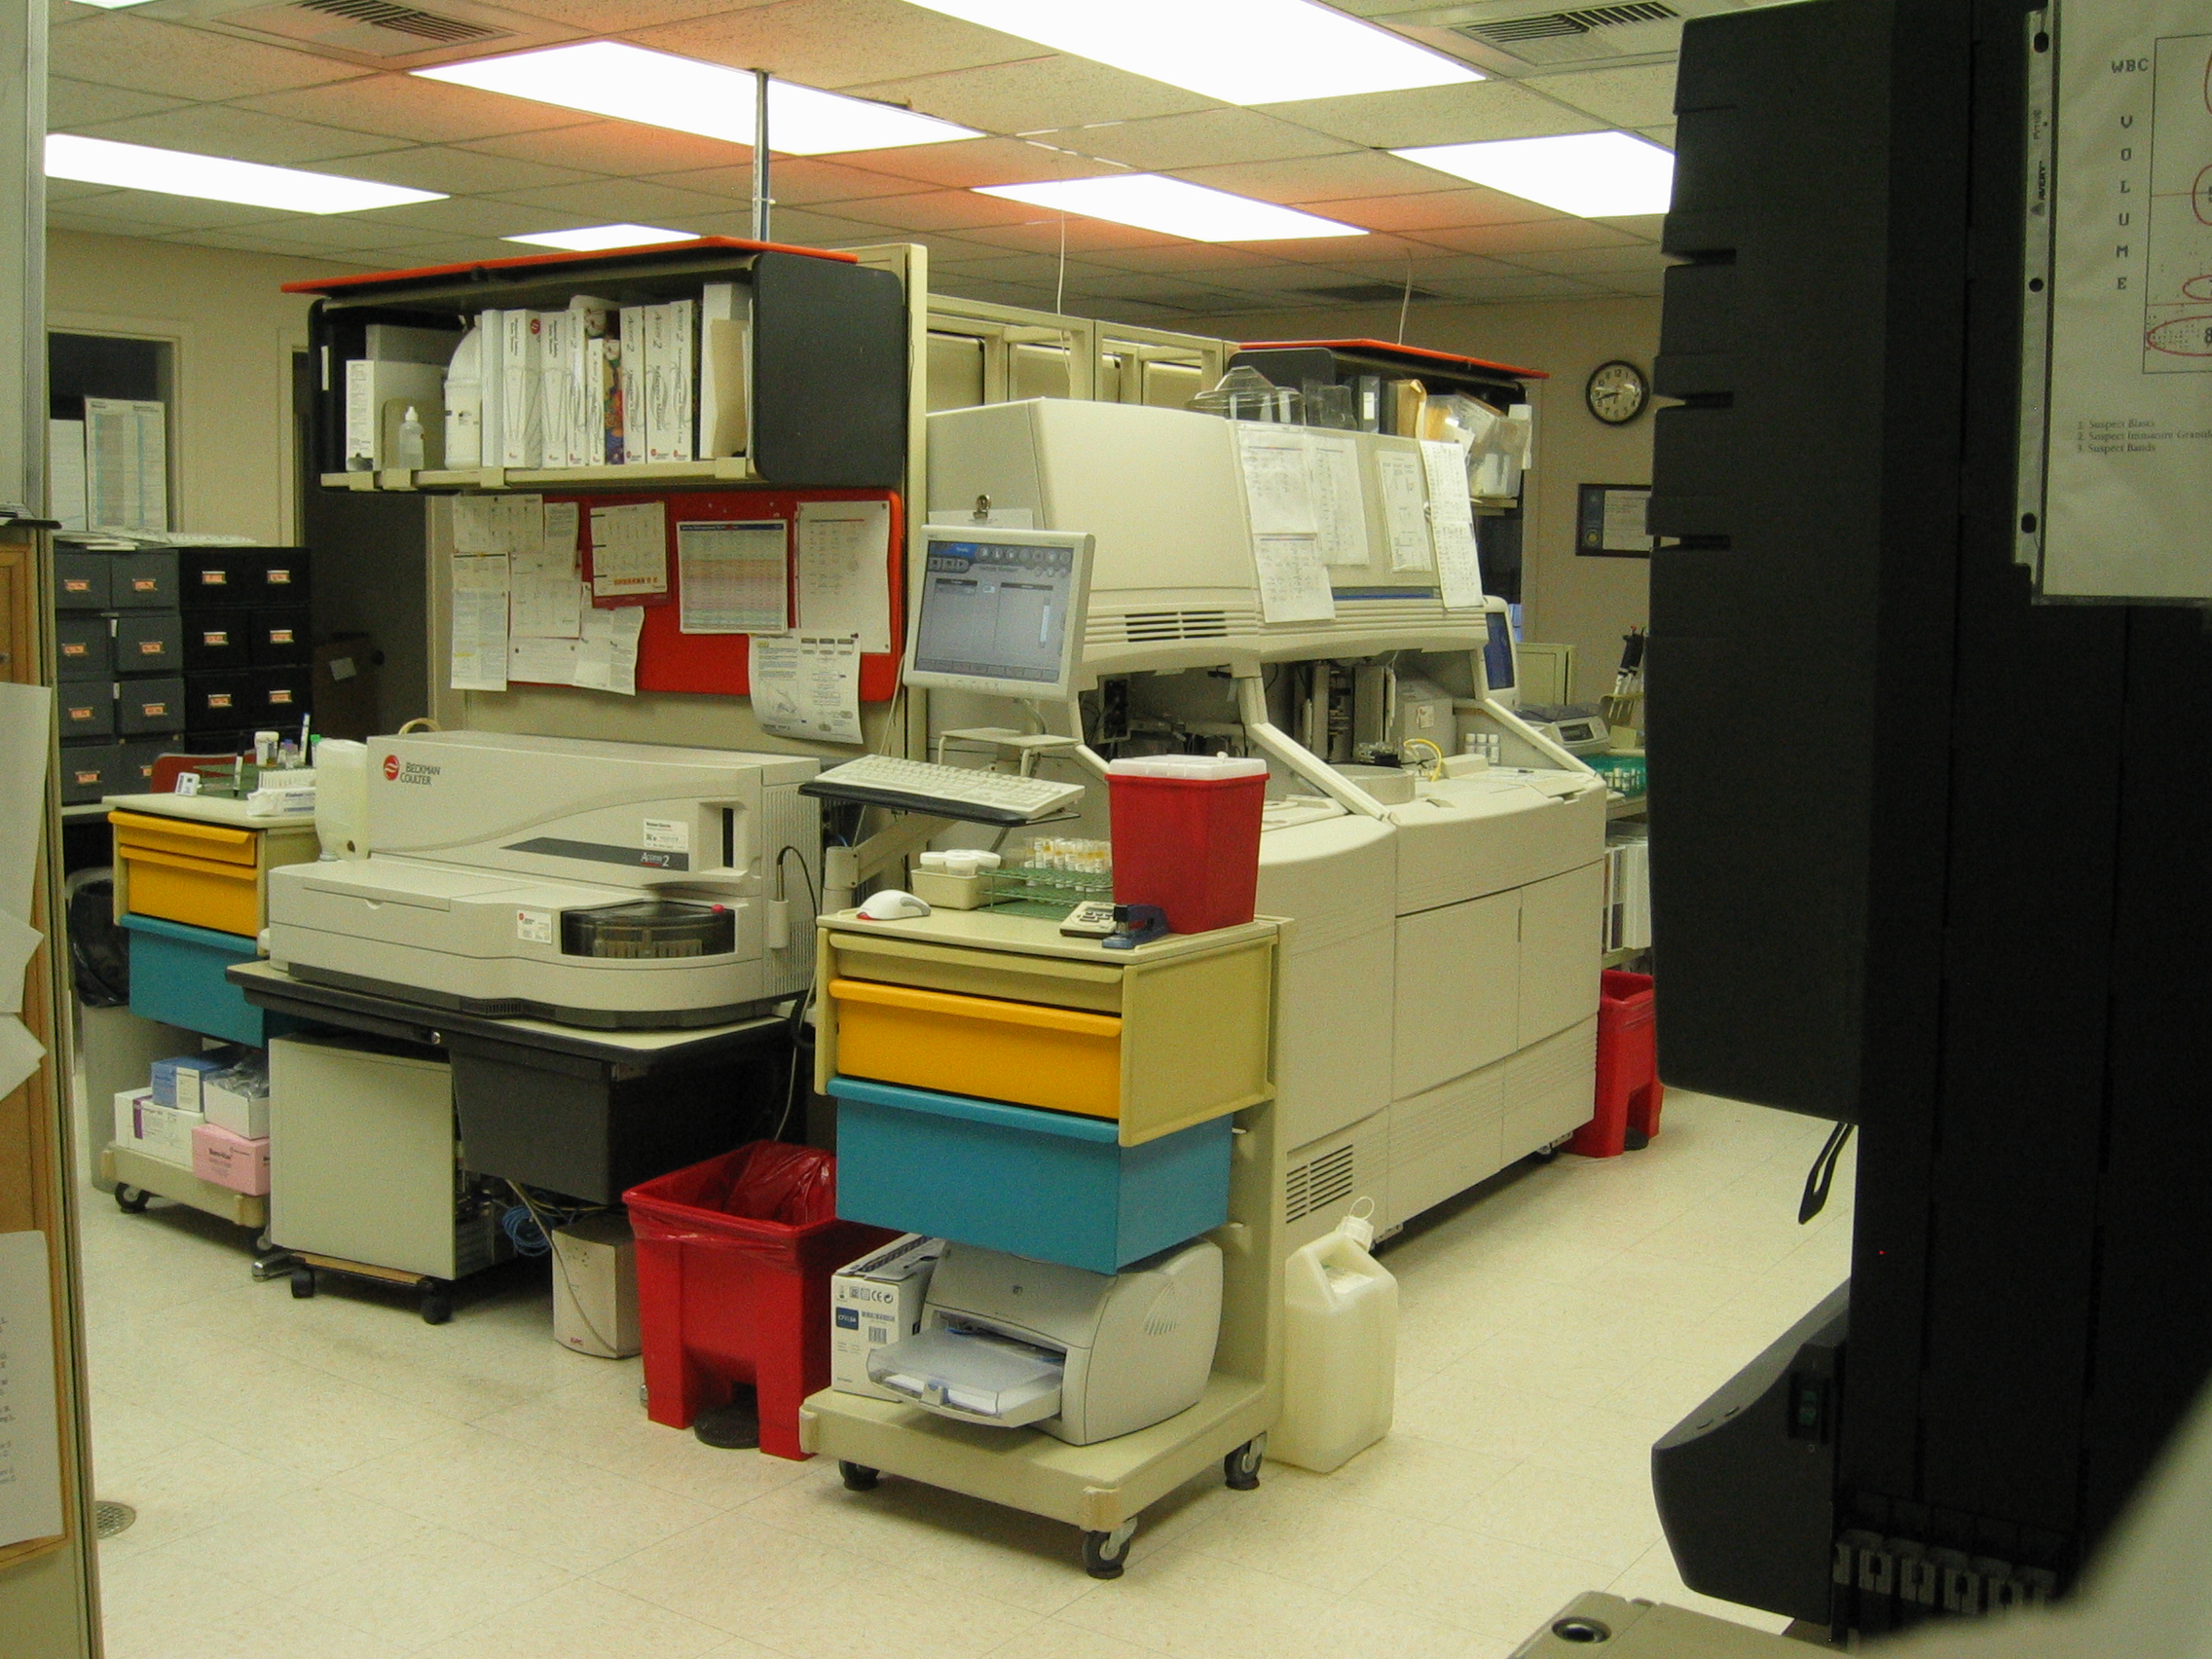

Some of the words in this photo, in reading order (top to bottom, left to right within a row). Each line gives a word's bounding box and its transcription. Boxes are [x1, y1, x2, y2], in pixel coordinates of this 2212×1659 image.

[2111, 58, 2149, 73] WBC
[405, 761, 441, 776] BECKMAN
[399, 772, 432, 786] COULTER
[661, 854, 670, 867] 2
